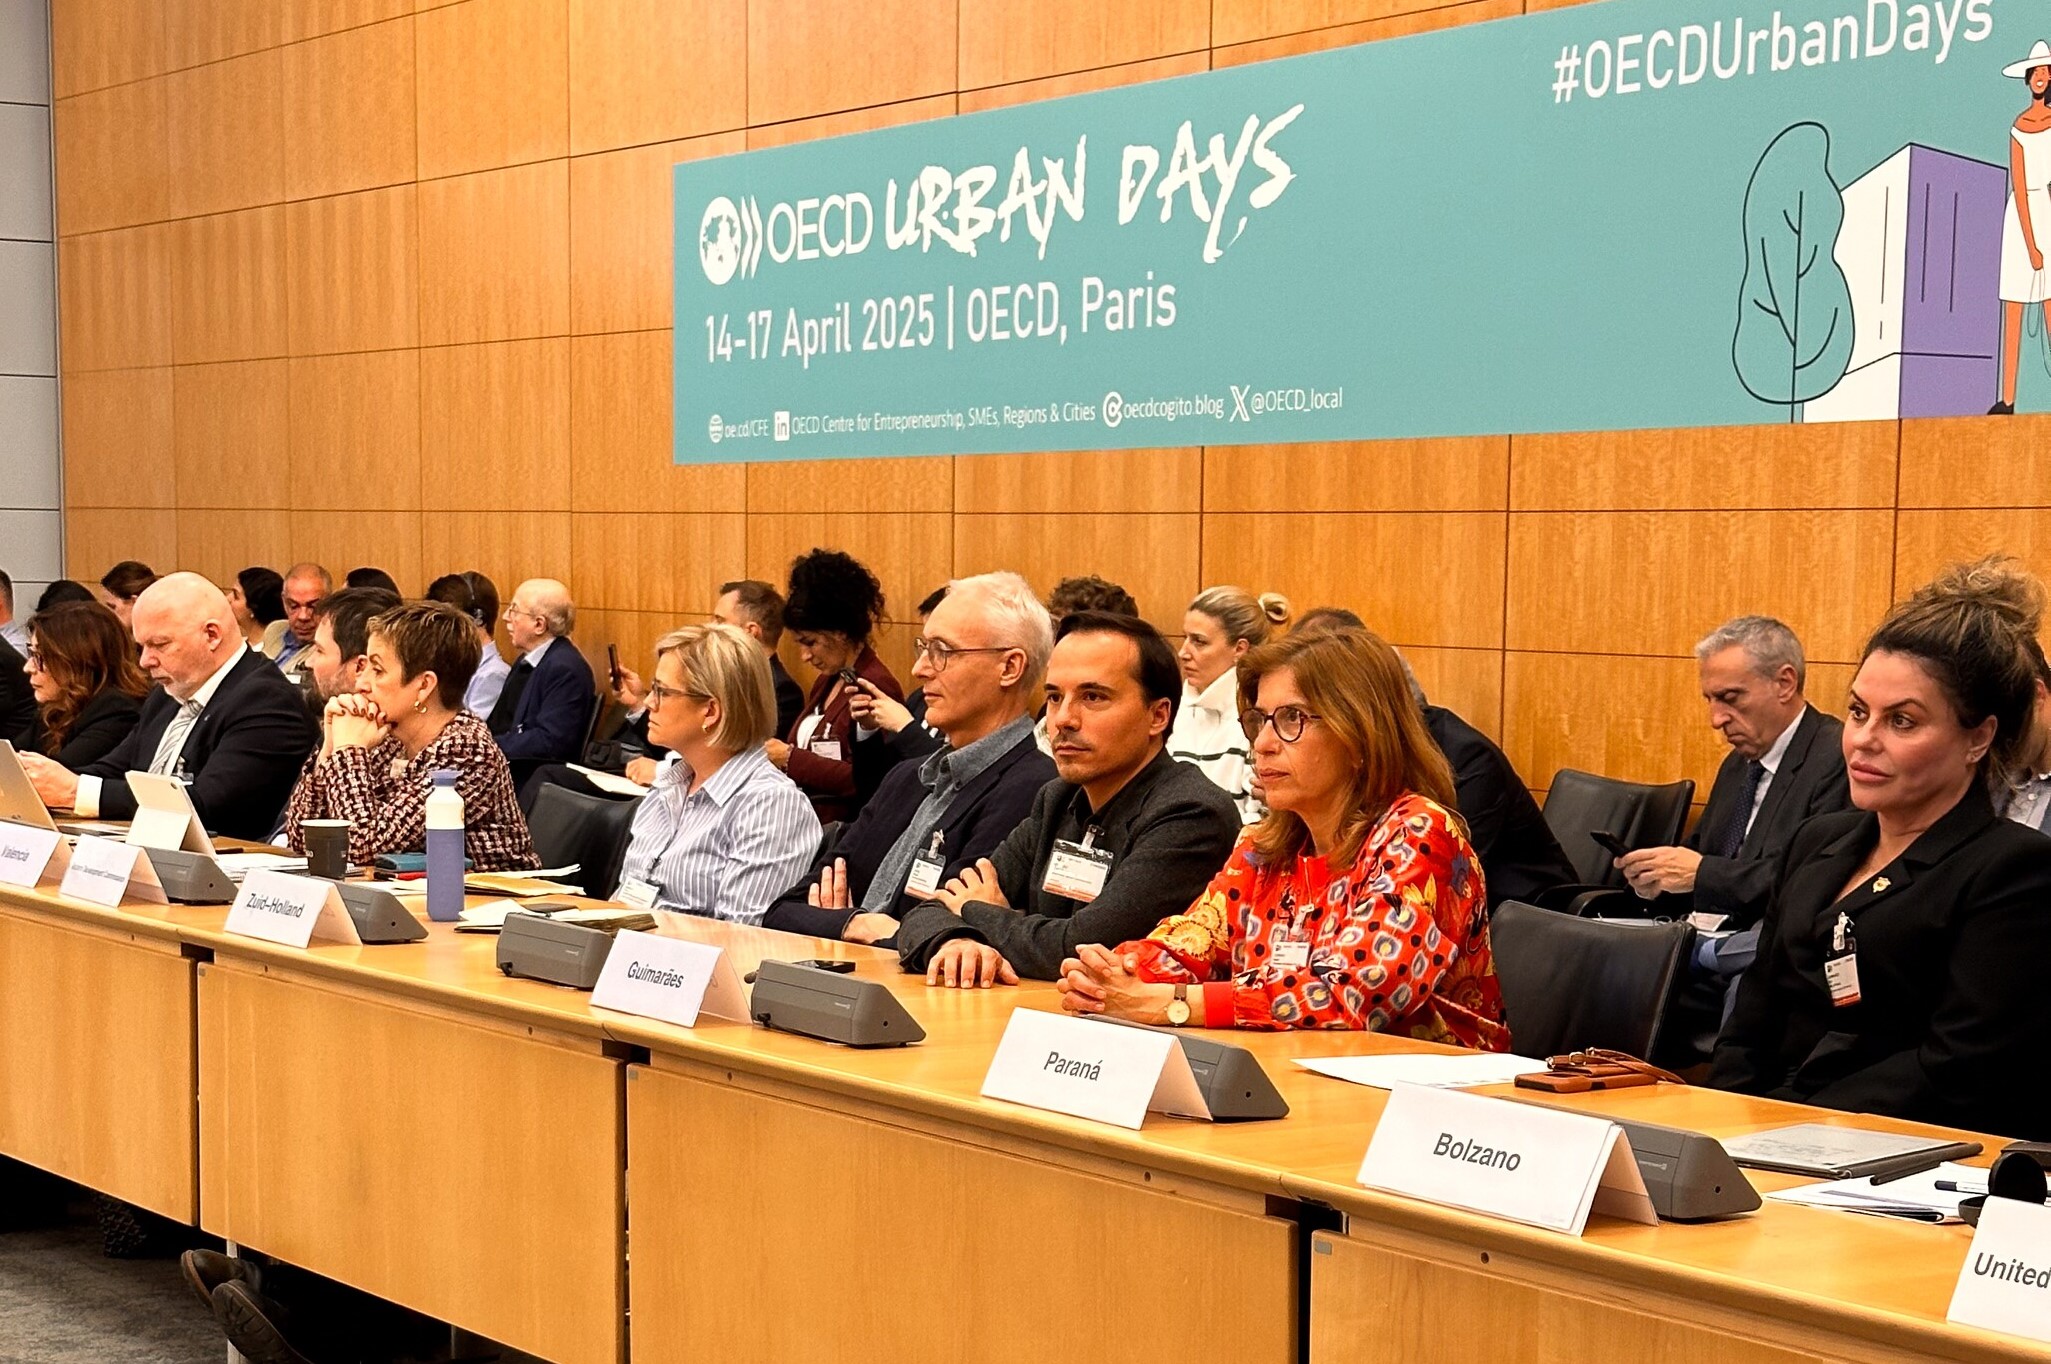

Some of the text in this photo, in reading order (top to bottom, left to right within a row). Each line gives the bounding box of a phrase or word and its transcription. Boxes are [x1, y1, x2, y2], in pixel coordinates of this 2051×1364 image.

[1551, 0, 1993, 104] #OECDUrbanDays
[766, 103, 1305, 264] OECD URBAN DAYS
[705, 307, 773, 363] 14-17
[781, 301, 852, 370] April
[862, 293, 935, 351] 2025
[966, 281, 1068, 345] OECD,
[1081, 270, 1177, 333] Paris
[1123, 395, 1225, 421] oecdcogito.blog
[1251, 386, 1343, 415] @OECD_local
[792, 401, 1096, 435] OECD Centre for Entrepreneurship, SMEs, Regions & Cities
[246, 893, 305, 918] Zuid-Holland
[627, 961, 685, 989] Guimarães
[1043, 1051, 1104, 1082] Paraná
[1433, 1133, 1521, 1172] Bolzano
[1974, 1252, 2051, 1289] United
